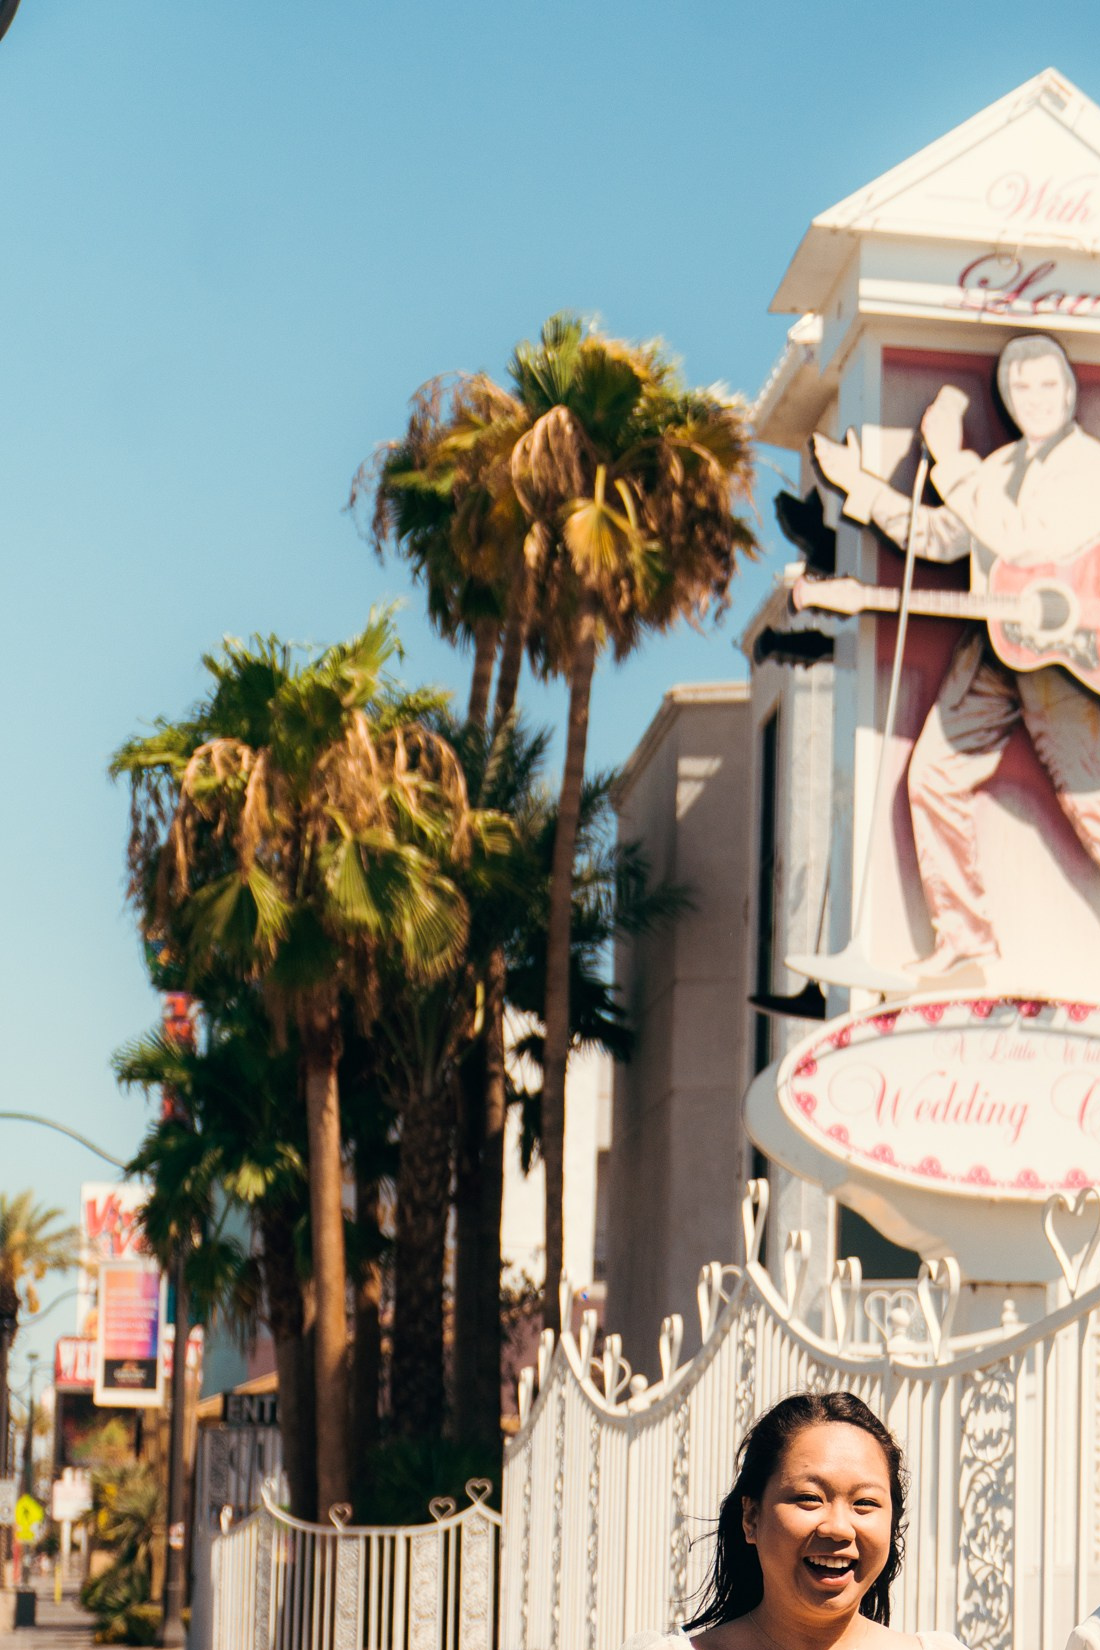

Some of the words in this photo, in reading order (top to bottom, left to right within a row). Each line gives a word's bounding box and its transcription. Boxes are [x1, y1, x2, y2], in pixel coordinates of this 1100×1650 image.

[985, 170, 1100, 225] With
[979, 1029, 1037, 1064] Little
[828, 1064, 1030, 1143] Wedding
